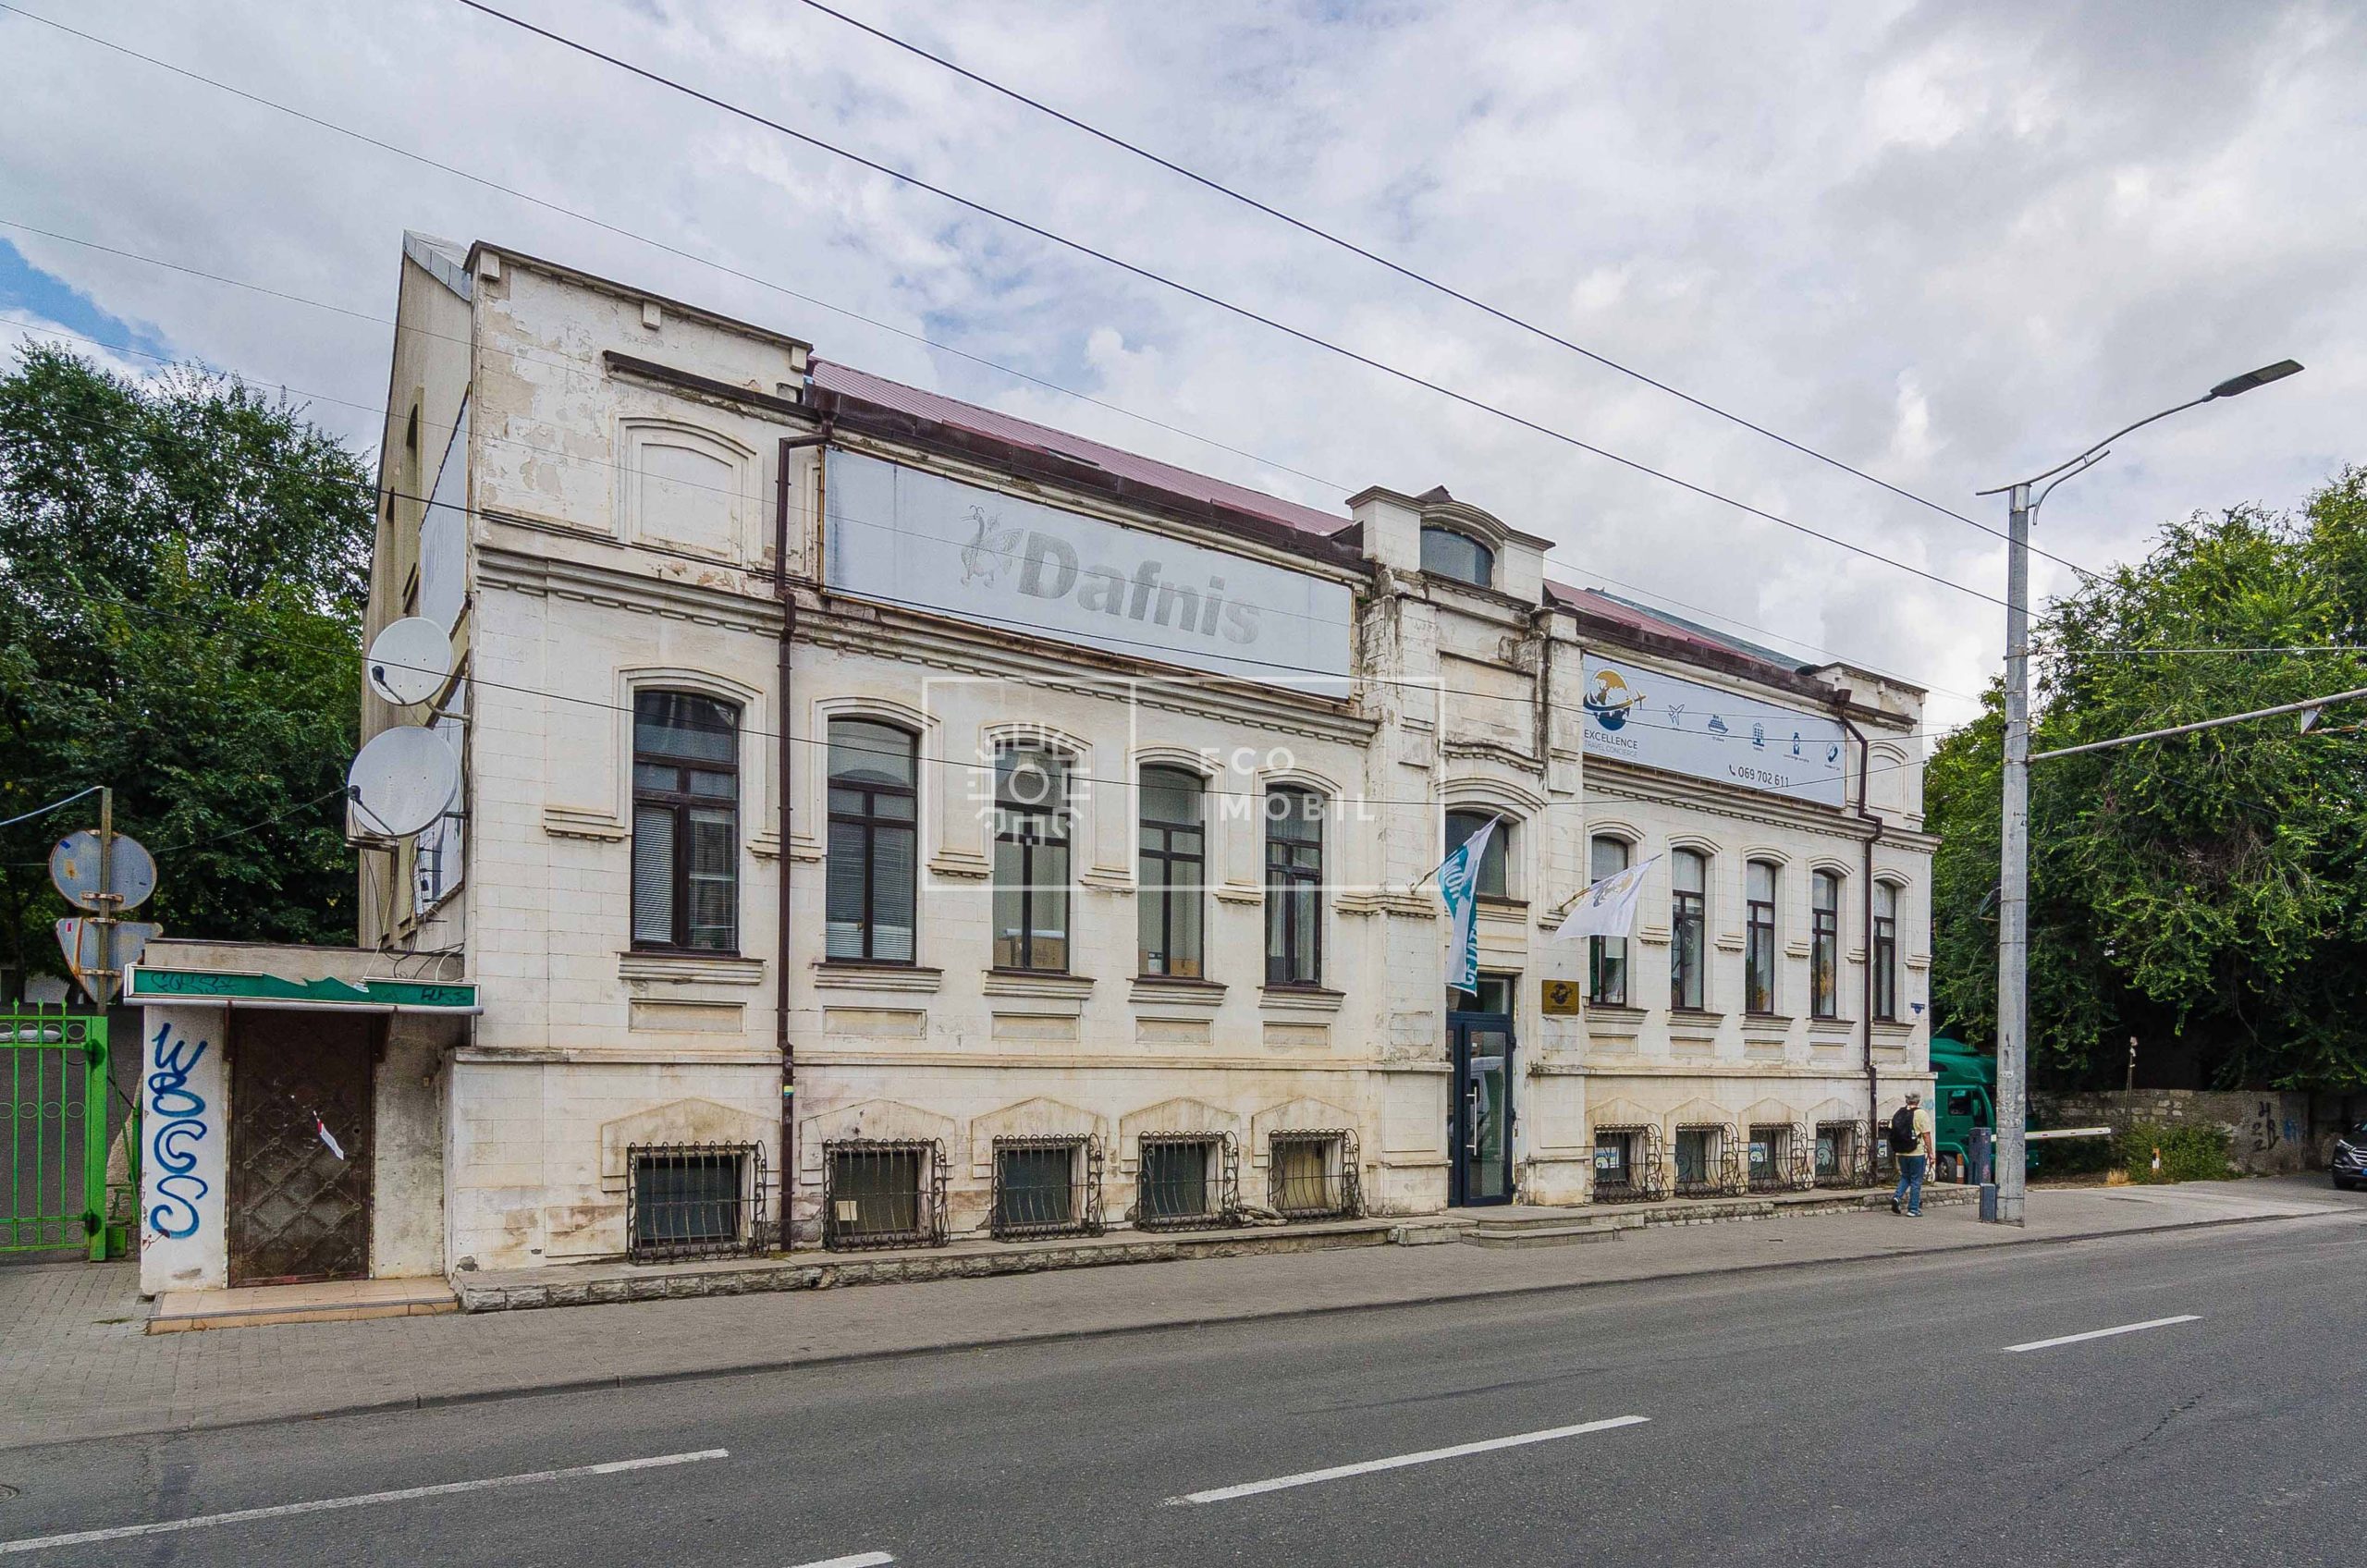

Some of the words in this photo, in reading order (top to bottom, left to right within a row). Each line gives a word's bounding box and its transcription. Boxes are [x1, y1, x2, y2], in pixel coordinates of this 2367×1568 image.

[1017, 530, 1261, 644] Dafnis
[1584, 729, 1638, 750] EXCELLENCE
[1738, 766, 1755, 780] 069
[1757, 770, 1772, 785] 702
[1774, 774, 1789, 788] 611
